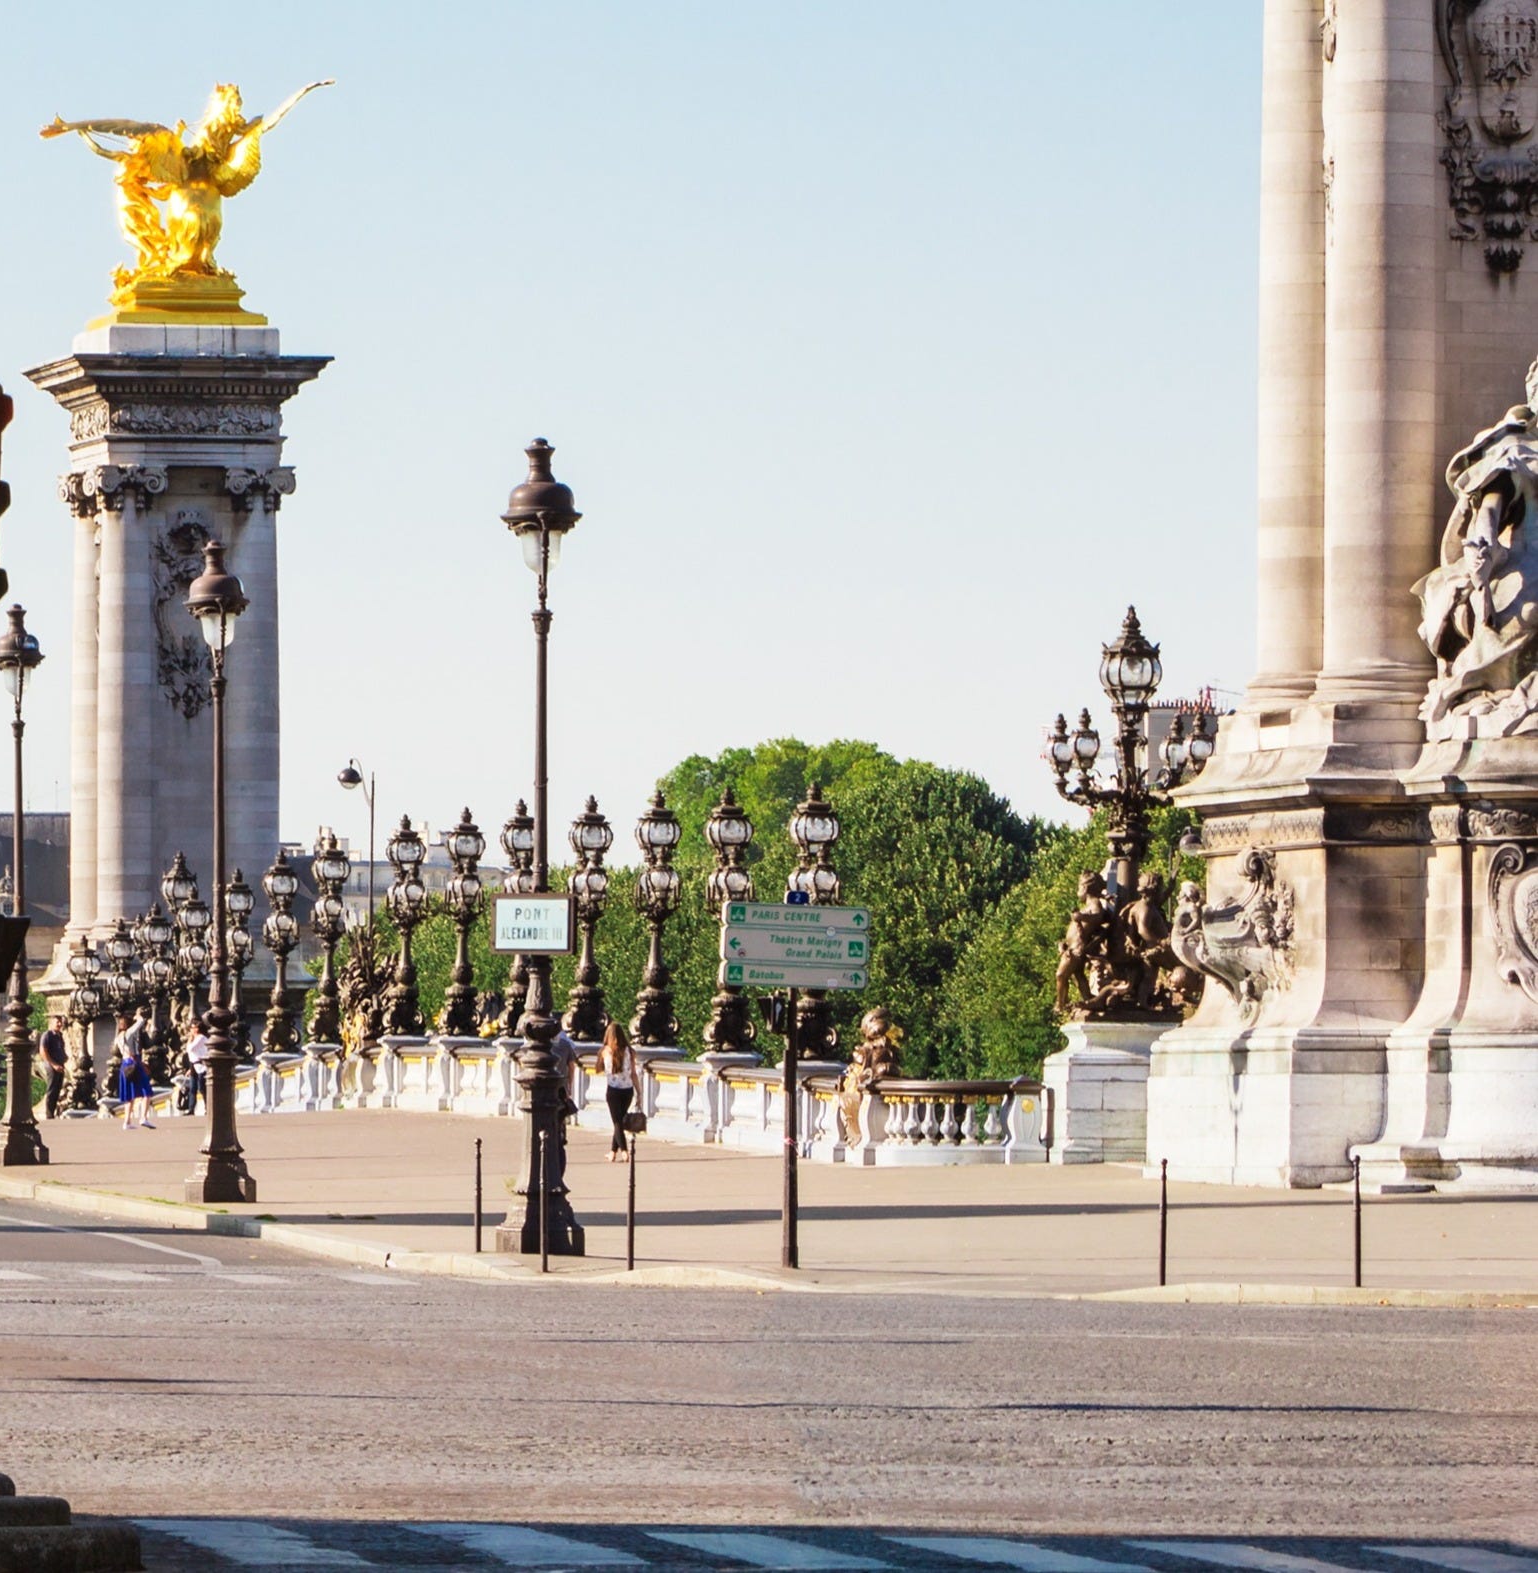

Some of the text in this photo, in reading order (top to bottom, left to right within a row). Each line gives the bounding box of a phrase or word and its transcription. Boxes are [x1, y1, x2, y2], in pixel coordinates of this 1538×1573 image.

[515, 908, 549, 920] PONT
[751, 911, 821, 923] PARIS CENTRE
[501, 928, 563, 940] ALEXANDRE III
[770, 934, 843, 948] Théâtre Marigny
[786, 948, 842, 960] Grand Palais
[749, 969, 785, 980] Batobus
